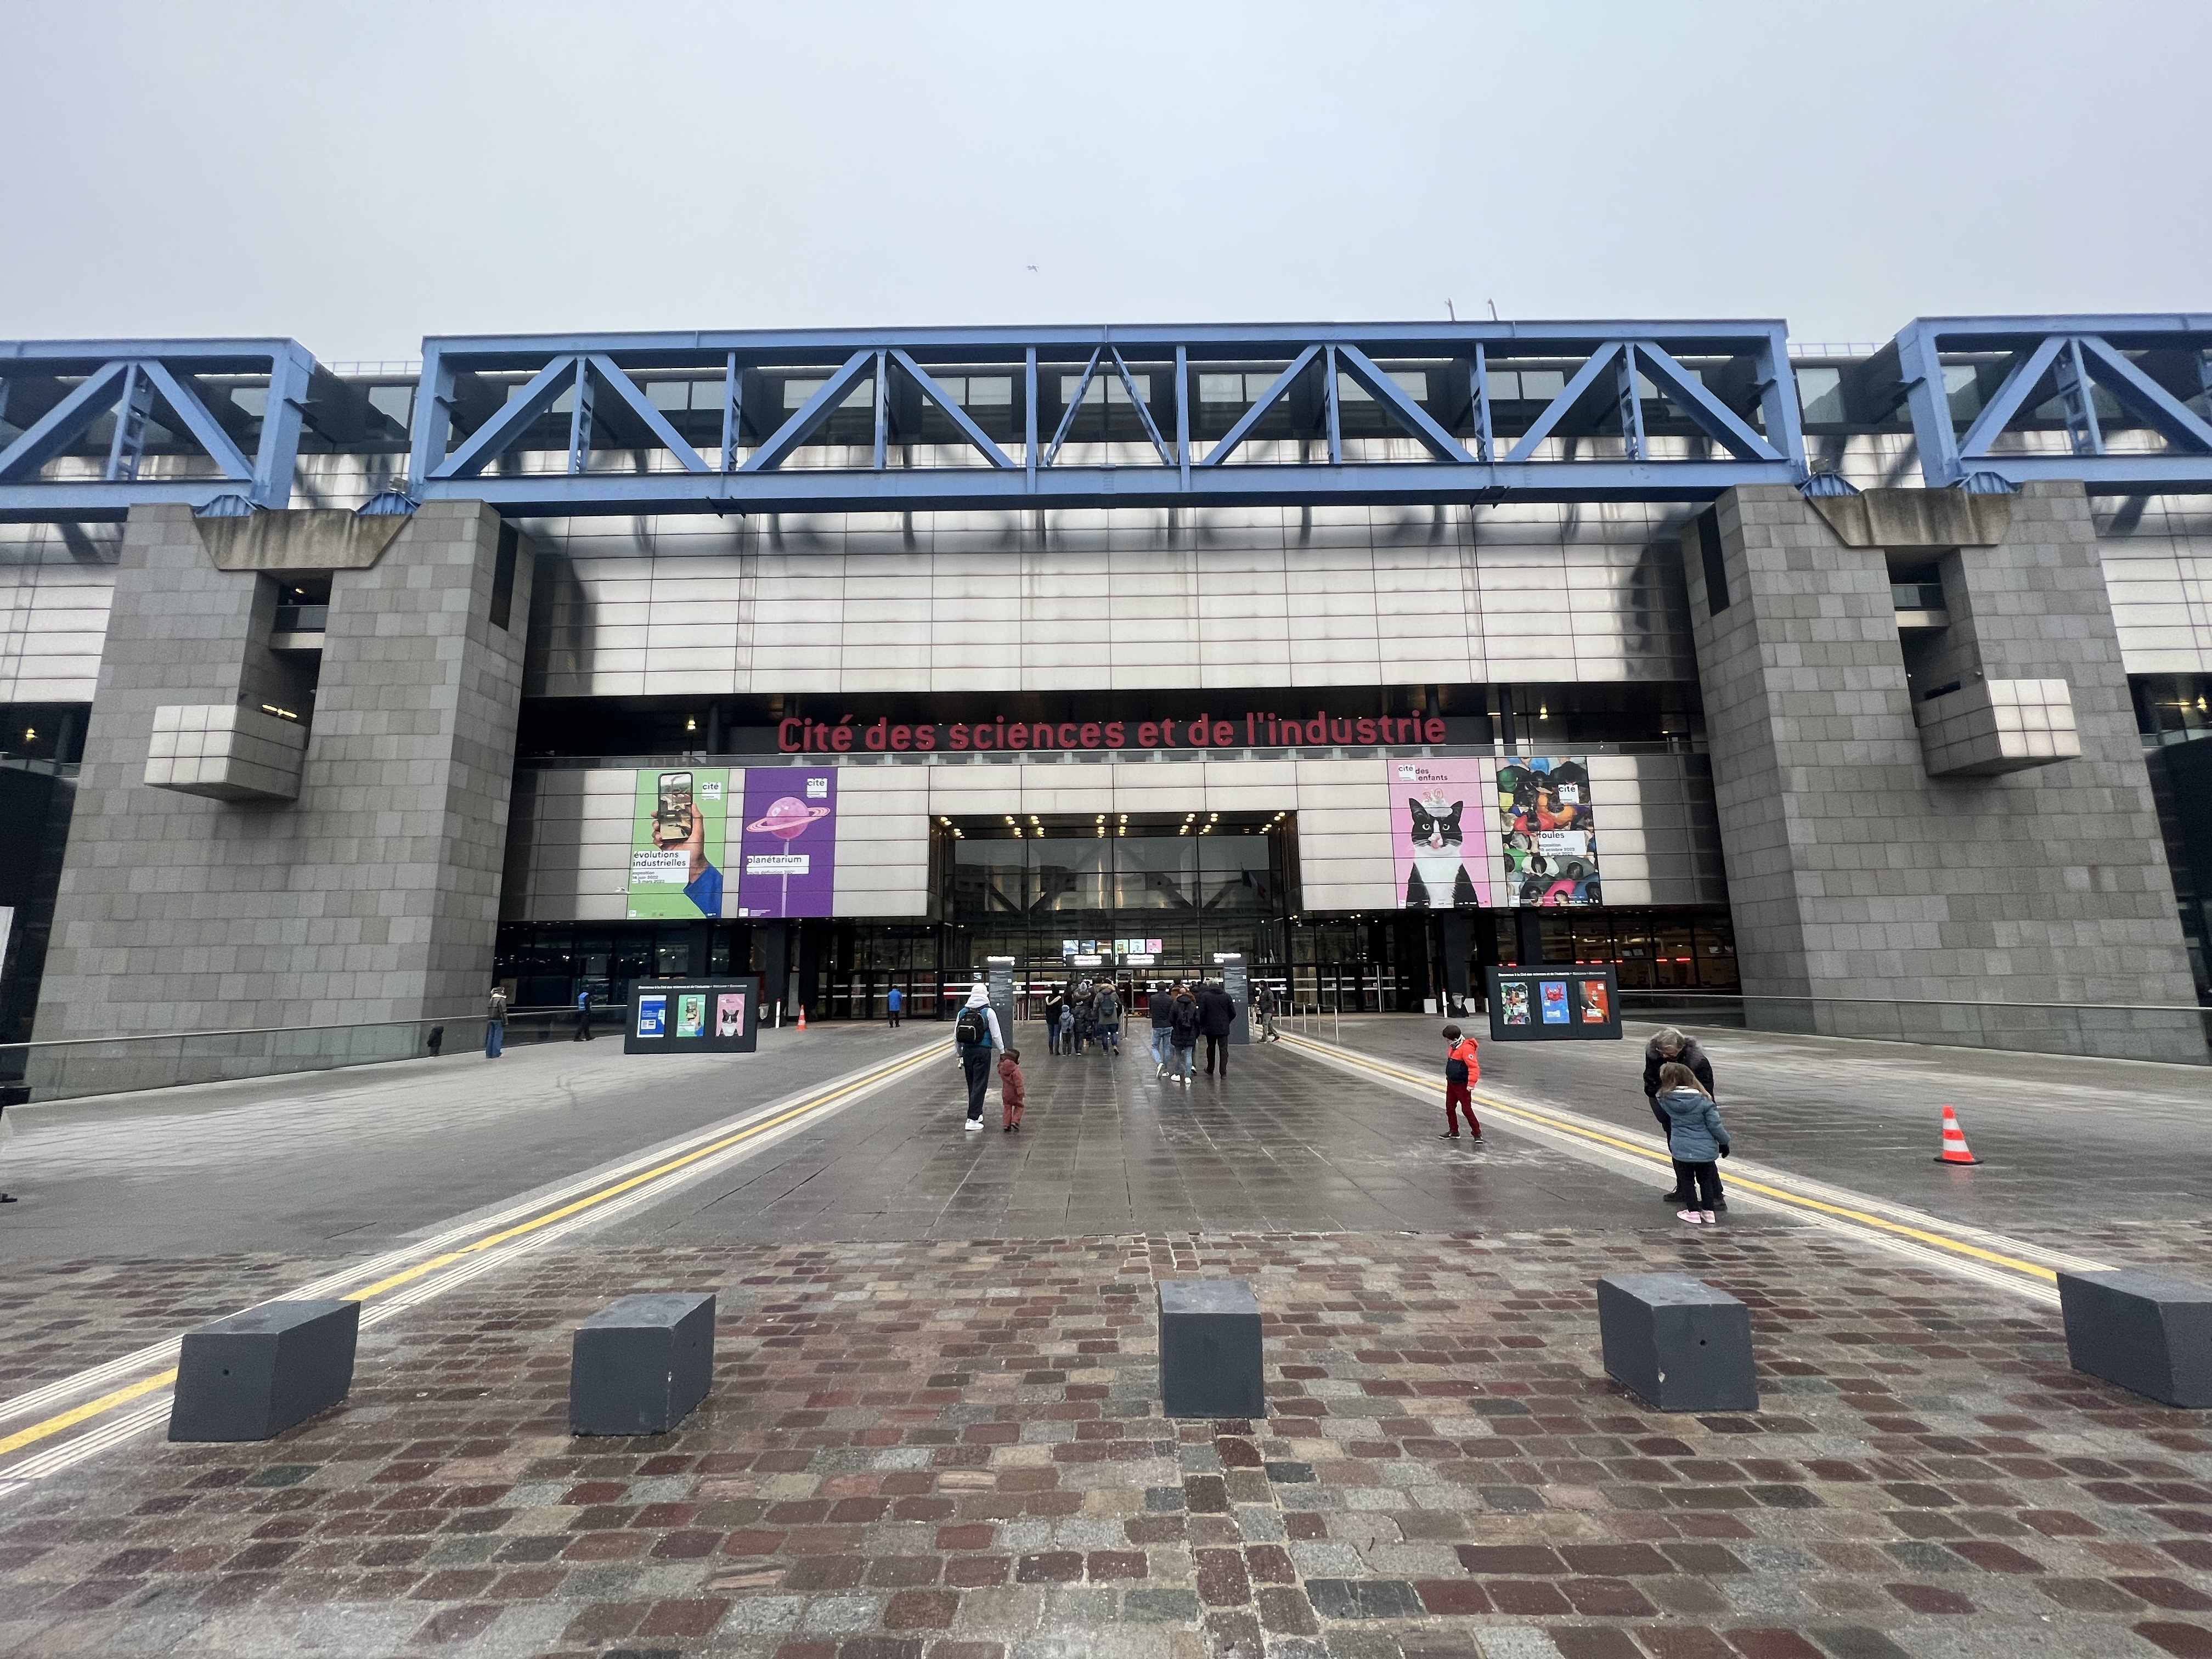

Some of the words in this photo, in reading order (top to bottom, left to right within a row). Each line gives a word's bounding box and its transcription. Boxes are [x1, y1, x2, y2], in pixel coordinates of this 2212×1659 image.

[778, 714, 853, 752] Cité
[865, 717, 935, 751] des
[949, 715, 1125, 750] sciences
[1137, 718, 1176, 747] et
[1188, 713, 1234, 747] de
[1246, 709, 1447, 746] l'industrie
[807, 777, 825, 786] cité
[702, 782, 719, 790] cité
[1558, 784, 1576, 792] cité
[1538, 831, 1565, 839] foules
[634, 849, 679, 858] évolutions
[633, 859, 686, 867] industrielles
[747, 855, 802, 865] planétarium
